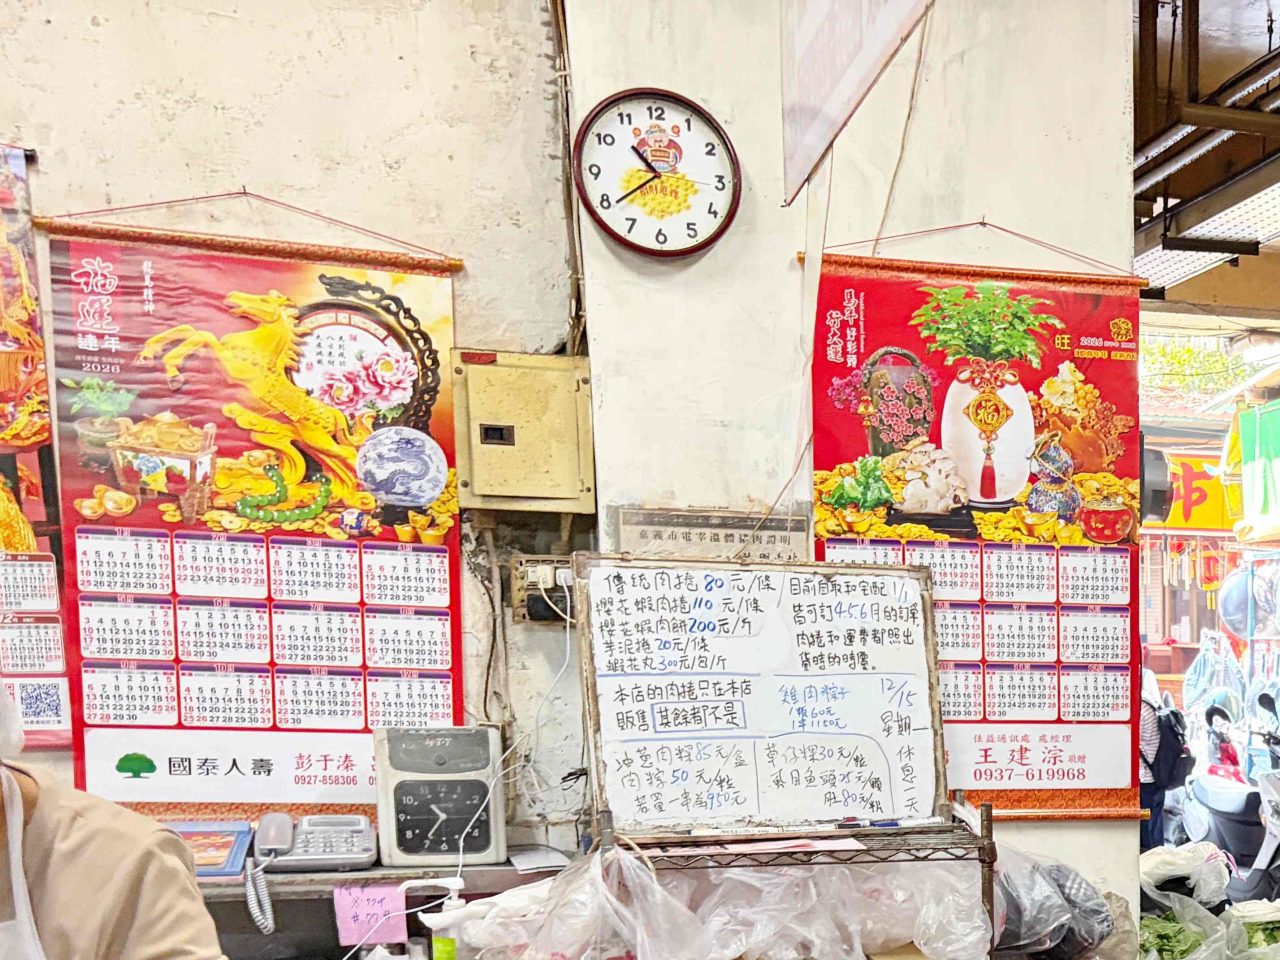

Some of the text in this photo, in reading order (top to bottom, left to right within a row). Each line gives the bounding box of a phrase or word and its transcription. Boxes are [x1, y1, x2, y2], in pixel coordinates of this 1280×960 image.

[617, 112, 632, 126] 11
[646, 106, 666, 121] 12
[685, 118, 691, 132] 1
[595, 132, 616, 147] 10
[705, 142, 716, 156] 2
[588, 163, 601, 181] 9
[714, 175, 726, 191] 3
[600, 193, 612, 210] 8
[707, 202, 718, 219] 4
[625, 217, 637, 234] 7
[686, 223, 698, 239] 5
[655, 228, 668, 245] 6
[1055, 334, 1071, 350] 旺
[1080, 336, 1103, 347] 2026
[82, 363, 120, 374] 2026
[977, 400, 998, 424] 福
[614, 679, 752, 705] 本店的肉捲只在本店
[616, 702, 740, 732] 販售 其餘都不是
[168, 755, 274, 777] 國泰人壽
[294, 774, 358, 786] 0927-858306
[973, 768, 1086, 781] 0937-619968
[402, 796, 414, 805] 10
[398, 813, 406, 822] 9
[424, 840, 430, 849] 7
